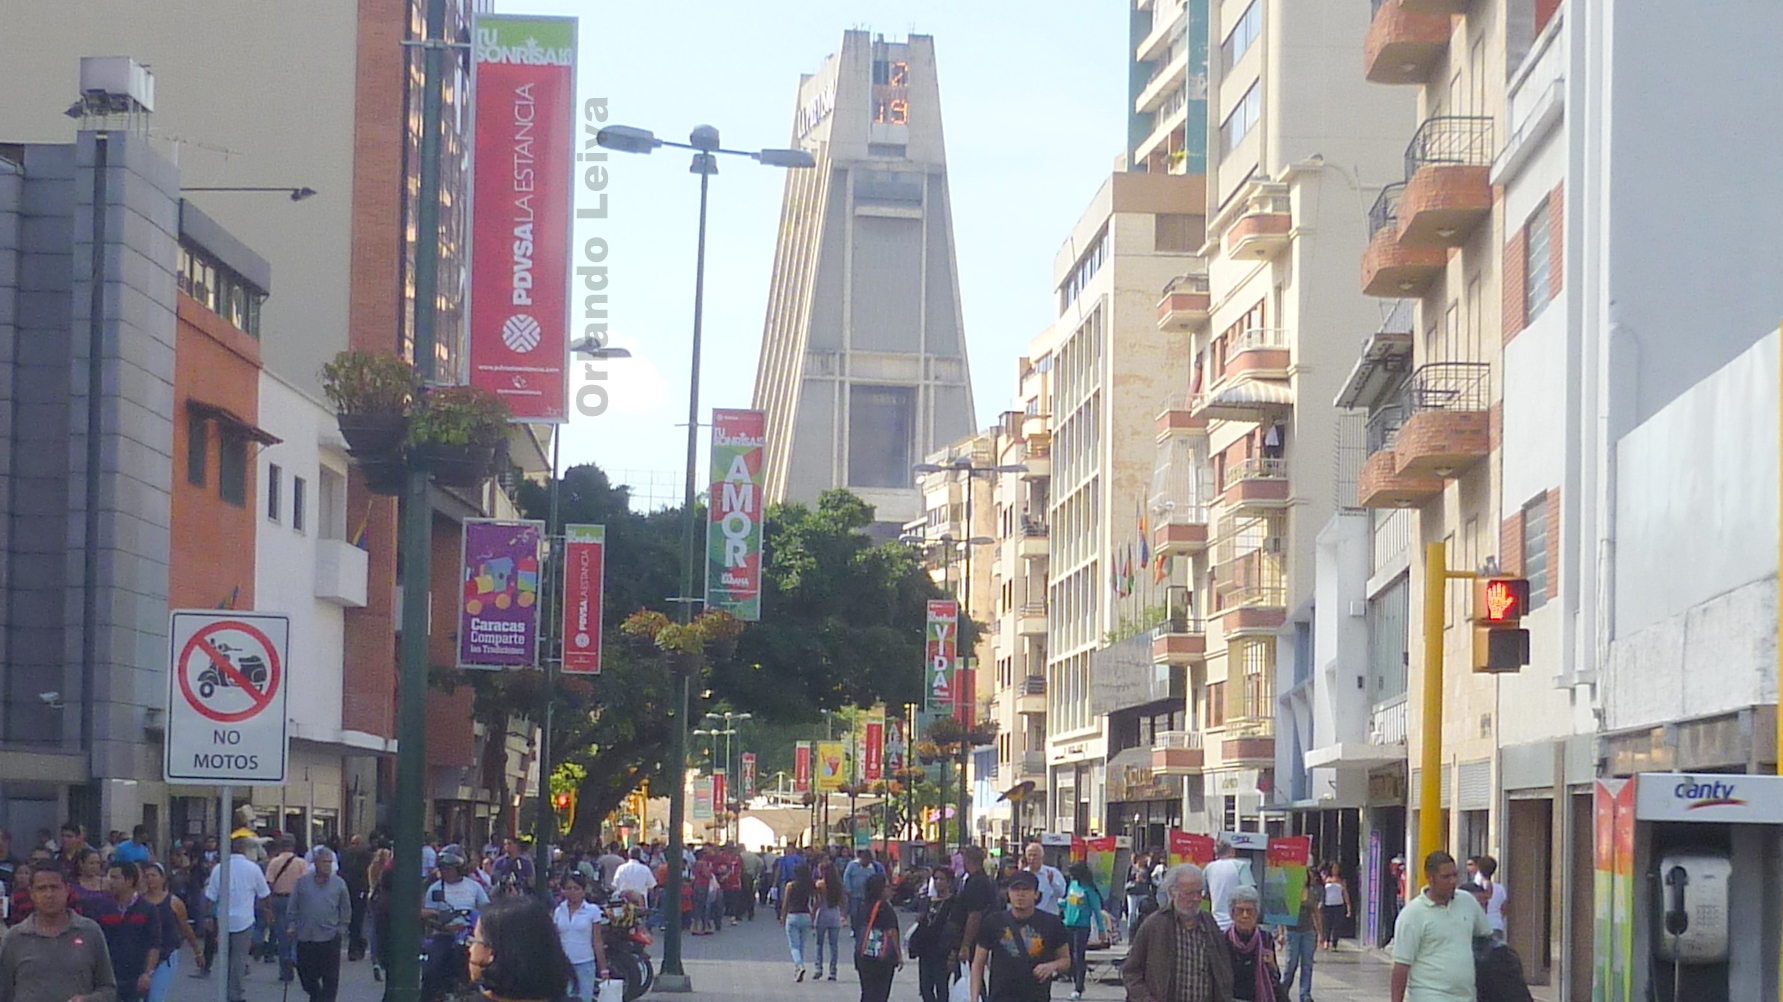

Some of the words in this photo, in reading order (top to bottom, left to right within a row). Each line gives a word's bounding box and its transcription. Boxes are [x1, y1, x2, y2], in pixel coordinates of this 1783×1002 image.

[477, 28, 498, 47] TU
[476, 44, 557, 66] SONRISA
[874, 99, 908, 124] 19
[514, 82, 535, 192] ESTANCIA
[514, 194, 534, 222] LA
[513, 223, 534, 306] PDVSA
[722, 454, 753, 569] AMOR
[470, 617, 526, 633] Caracas
[470, 631, 525, 648] Comparte
[213, 729, 241, 745] NO
[193, 753, 259, 770] MOTOS
